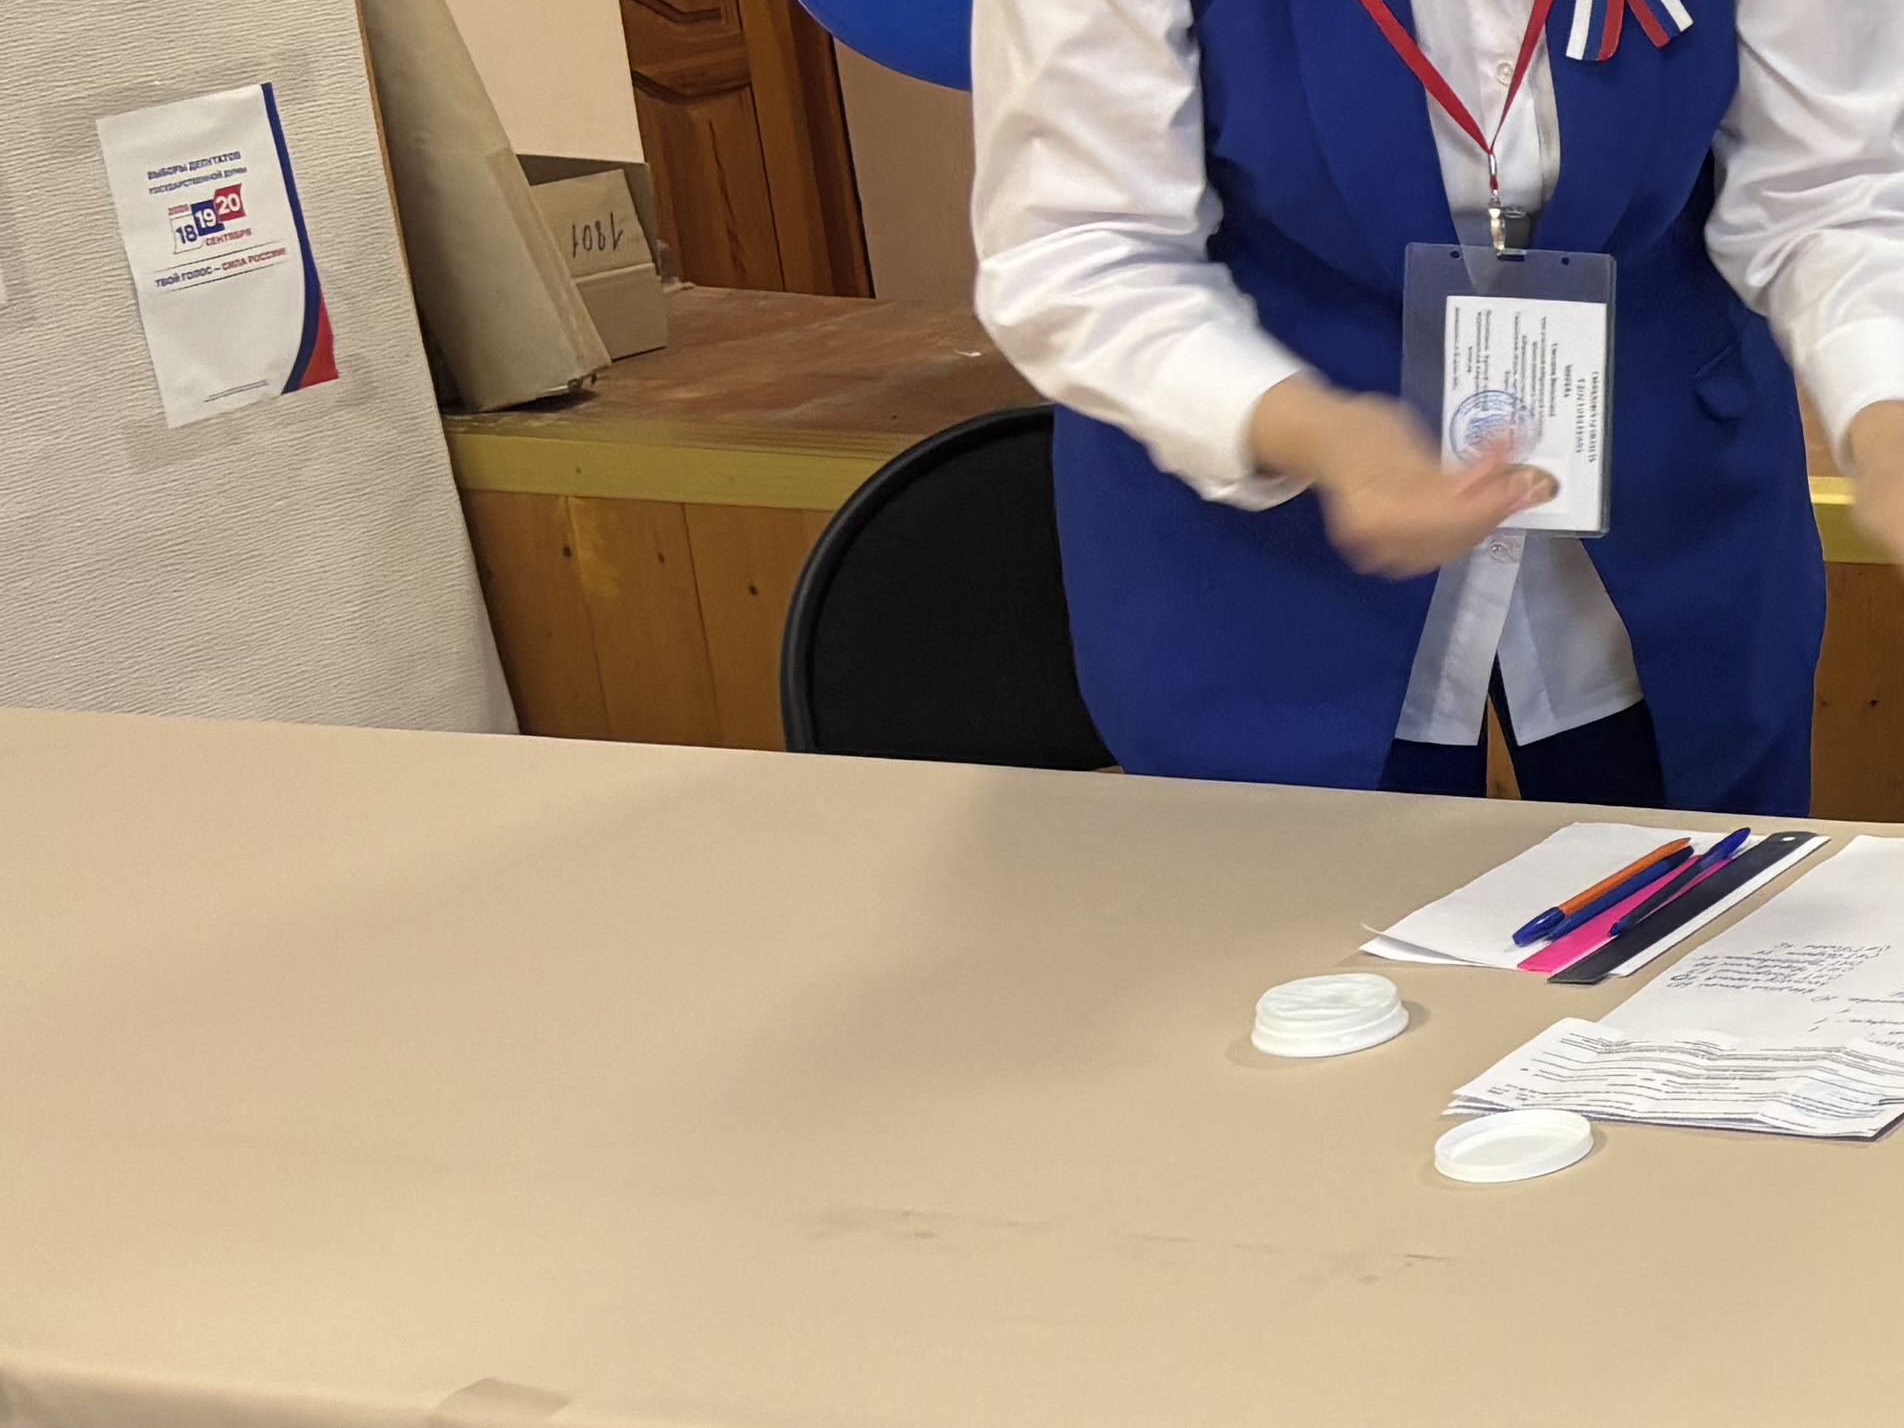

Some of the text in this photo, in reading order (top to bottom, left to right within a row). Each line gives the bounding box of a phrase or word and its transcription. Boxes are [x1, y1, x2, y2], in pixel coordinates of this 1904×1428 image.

[148, 151, 241, 180] ВЫБОРЫ ДЕПУТАТОВ
[149, 172, 223, 194] ГОСУДАРСТВЕННОЙ
[175, 193, 241, 244] 18 19 20
[205, 227, 252, 246] СЕНТЯБРЯ
[155, 274, 181, 287] ТВОЙ
[182, 266, 213, 281] ГОЛОС
[222, 257, 250, 271] СИЛА
